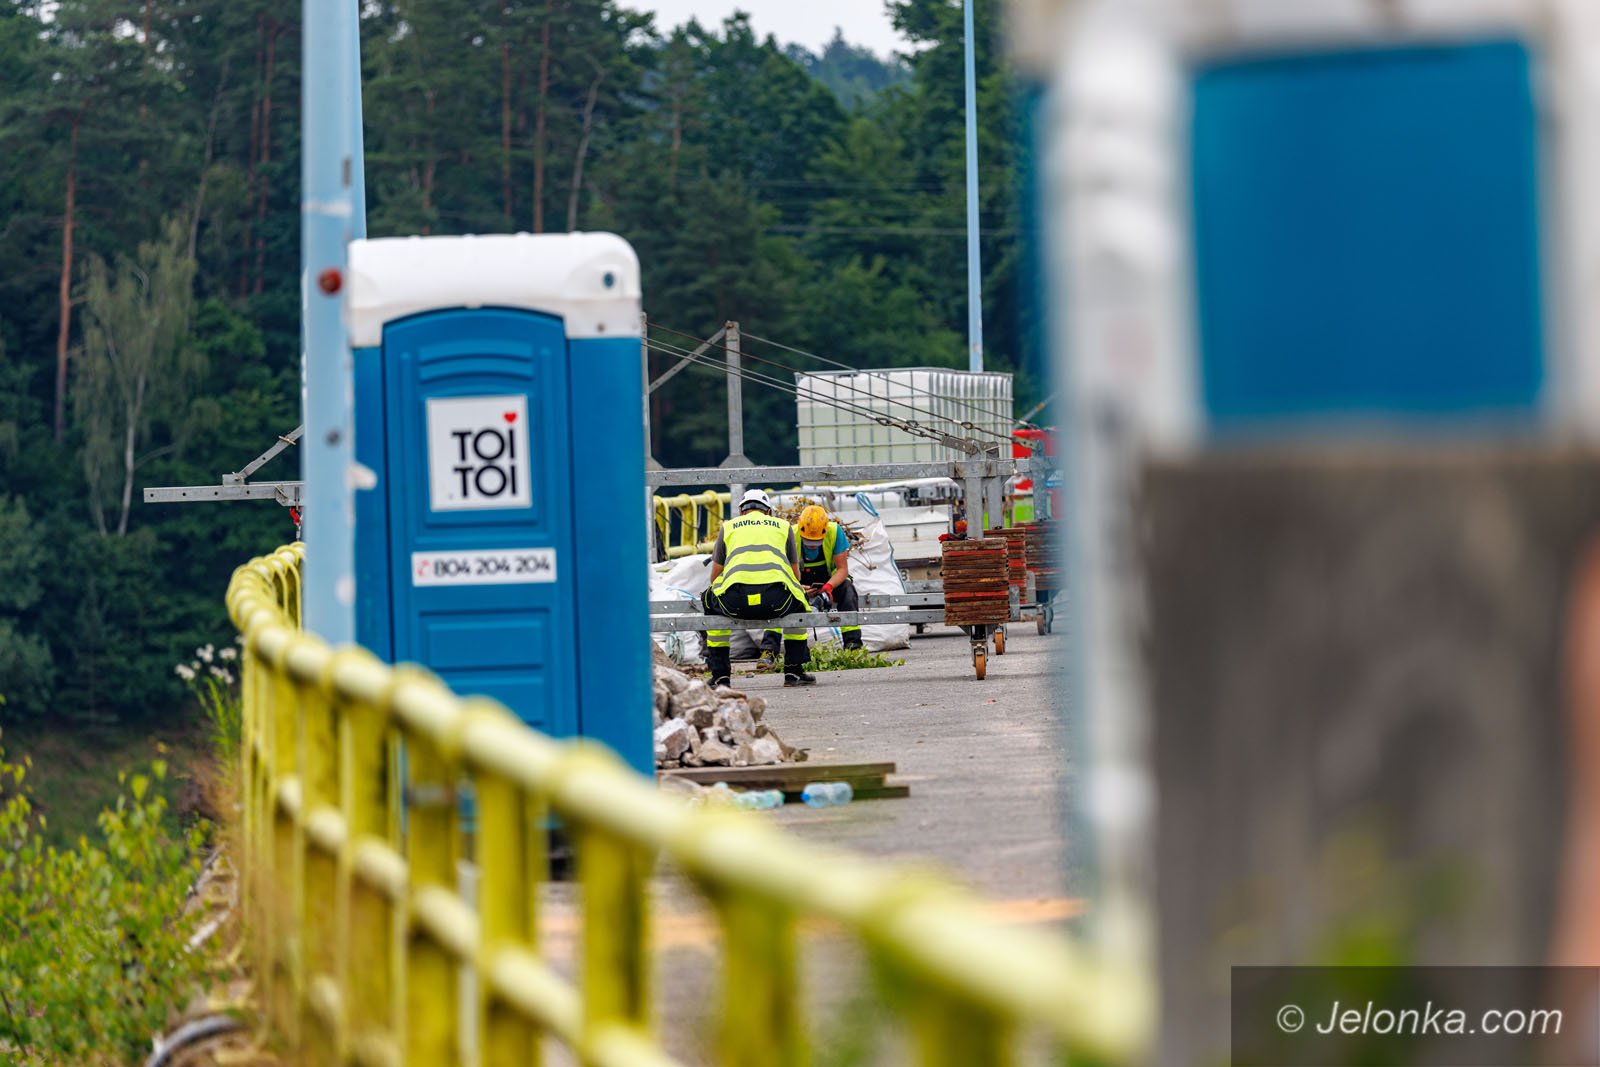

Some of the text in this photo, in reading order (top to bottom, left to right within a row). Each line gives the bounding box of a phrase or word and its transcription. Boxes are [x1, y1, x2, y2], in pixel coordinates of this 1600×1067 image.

[451, 429, 515, 461] TOI
[454, 465, 517, 498] TOI
[733, 519, 781, 530] NAVIGA-STAL
[476, 556, 510, 575] 204
[515, 554, 550, 573] 204
